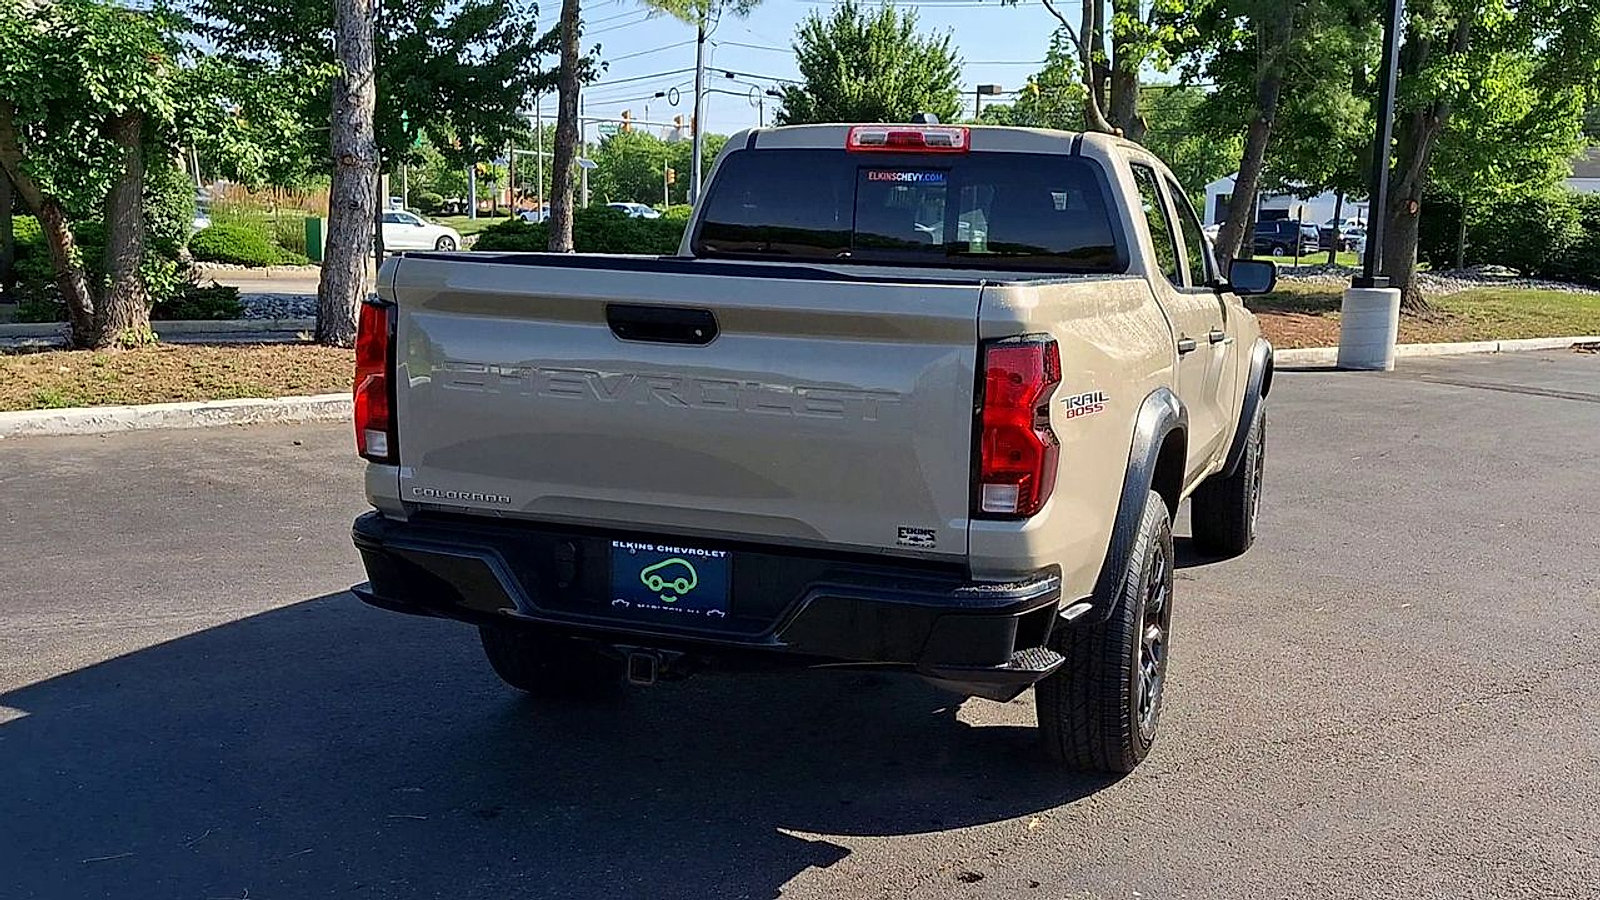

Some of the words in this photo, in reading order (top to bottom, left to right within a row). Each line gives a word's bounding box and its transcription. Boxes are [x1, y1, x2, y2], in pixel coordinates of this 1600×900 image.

[868, 171, 944, 182] ELKINSCHEVY.COM
[442, 361, 901, 421] CHEVROLET
[1061, 391, 1110, 409] TRAIL
[1066, 402, 1104, 419] BOSS
[412, 487, 511, 503] COLORADO
[612, 540, 654, 551] ELKINS
[656, 546, 726, 558] CHEVROLET
